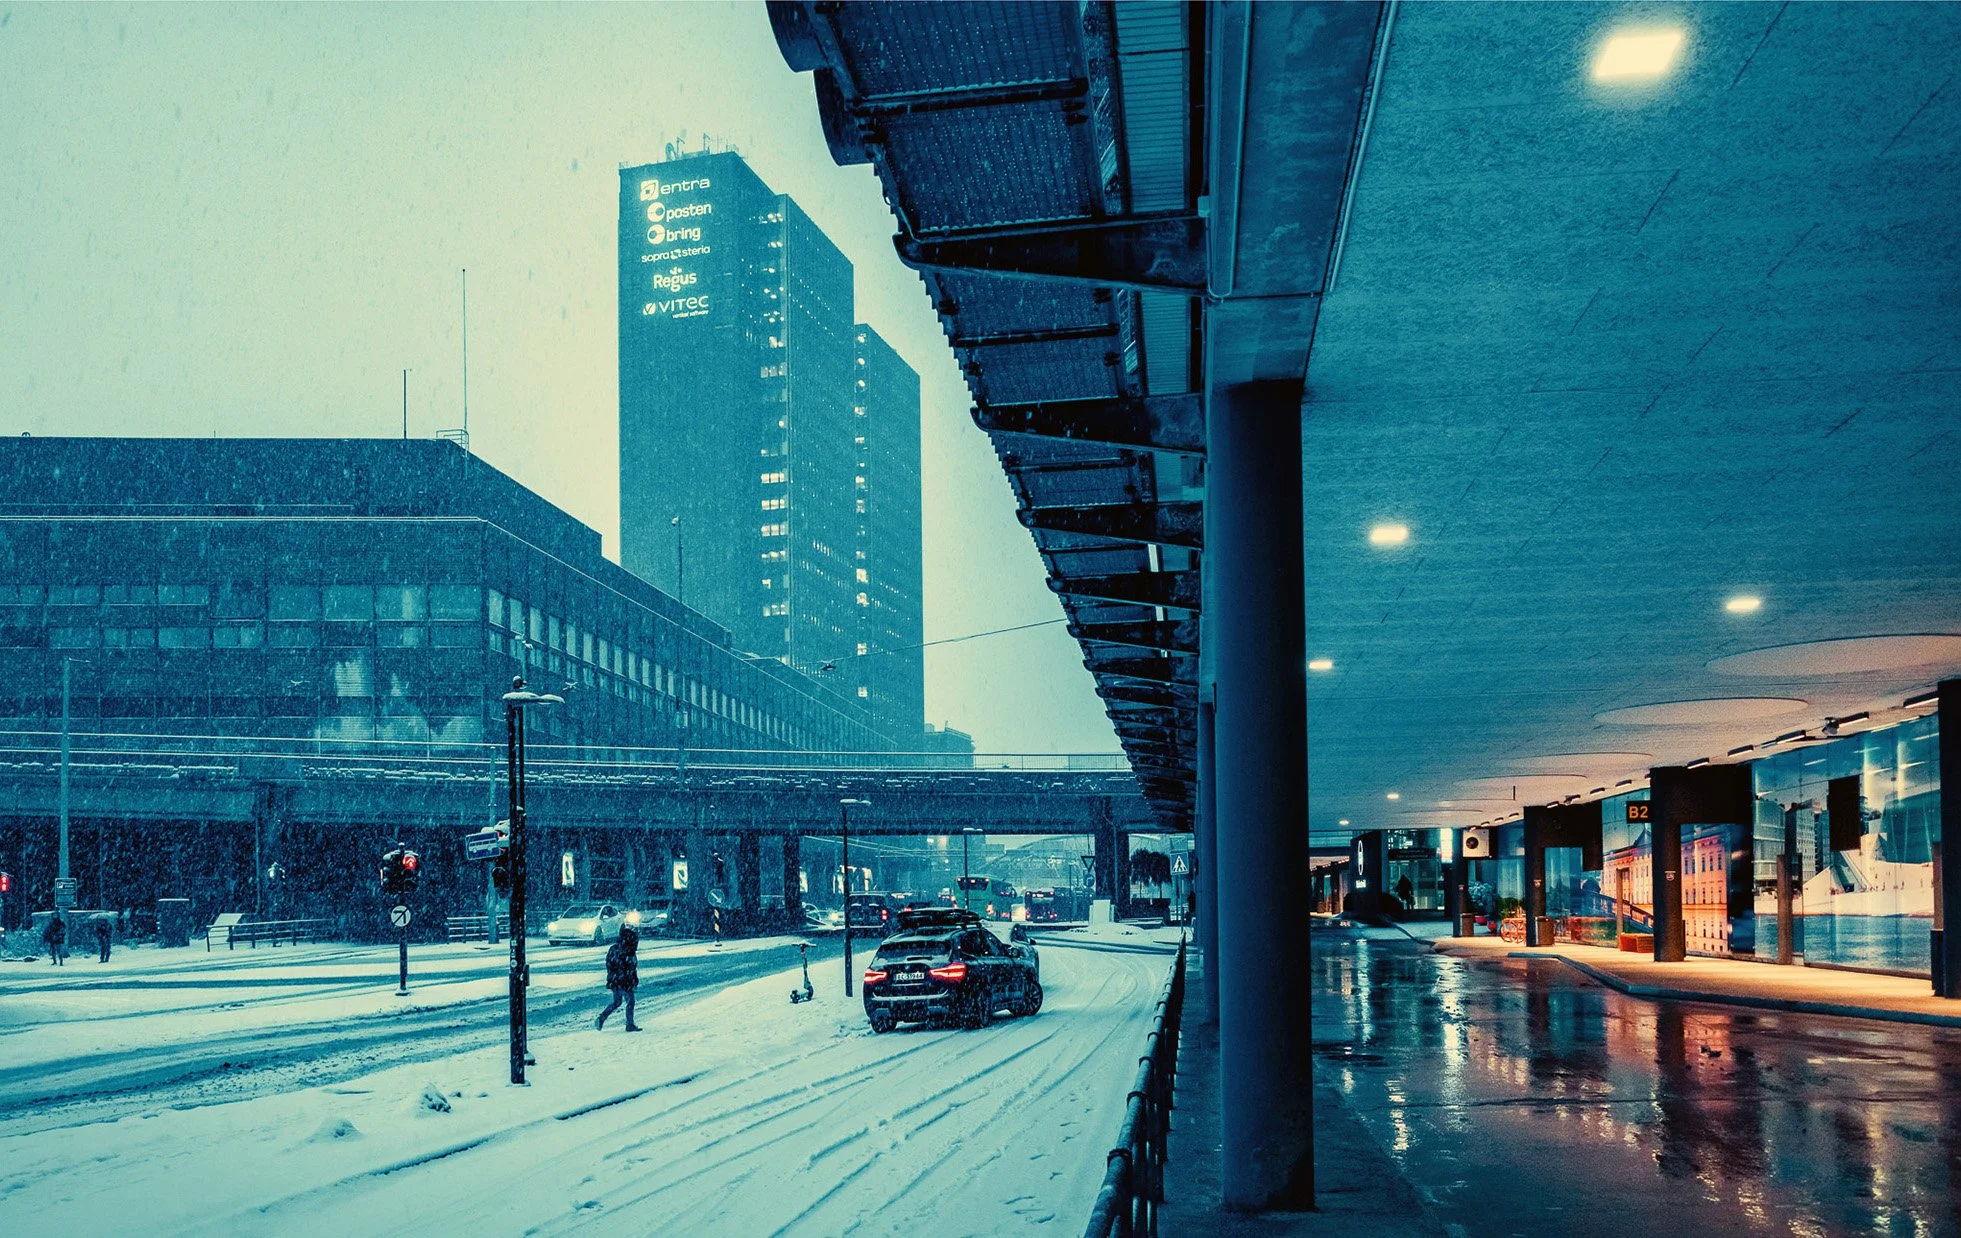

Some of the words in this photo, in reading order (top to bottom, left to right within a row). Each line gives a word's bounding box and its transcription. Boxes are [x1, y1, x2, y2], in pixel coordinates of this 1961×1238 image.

[661, 179, 710, 194] entra
[666, 203, 712, 222] posten
[666, 227, 701, 241] bring
[641, 252, 670, 263] sopra
[682, 245, 711, 257] steria
[653, 273, 697, 292] Regus
[1629, 806, 1648, 818] B2
